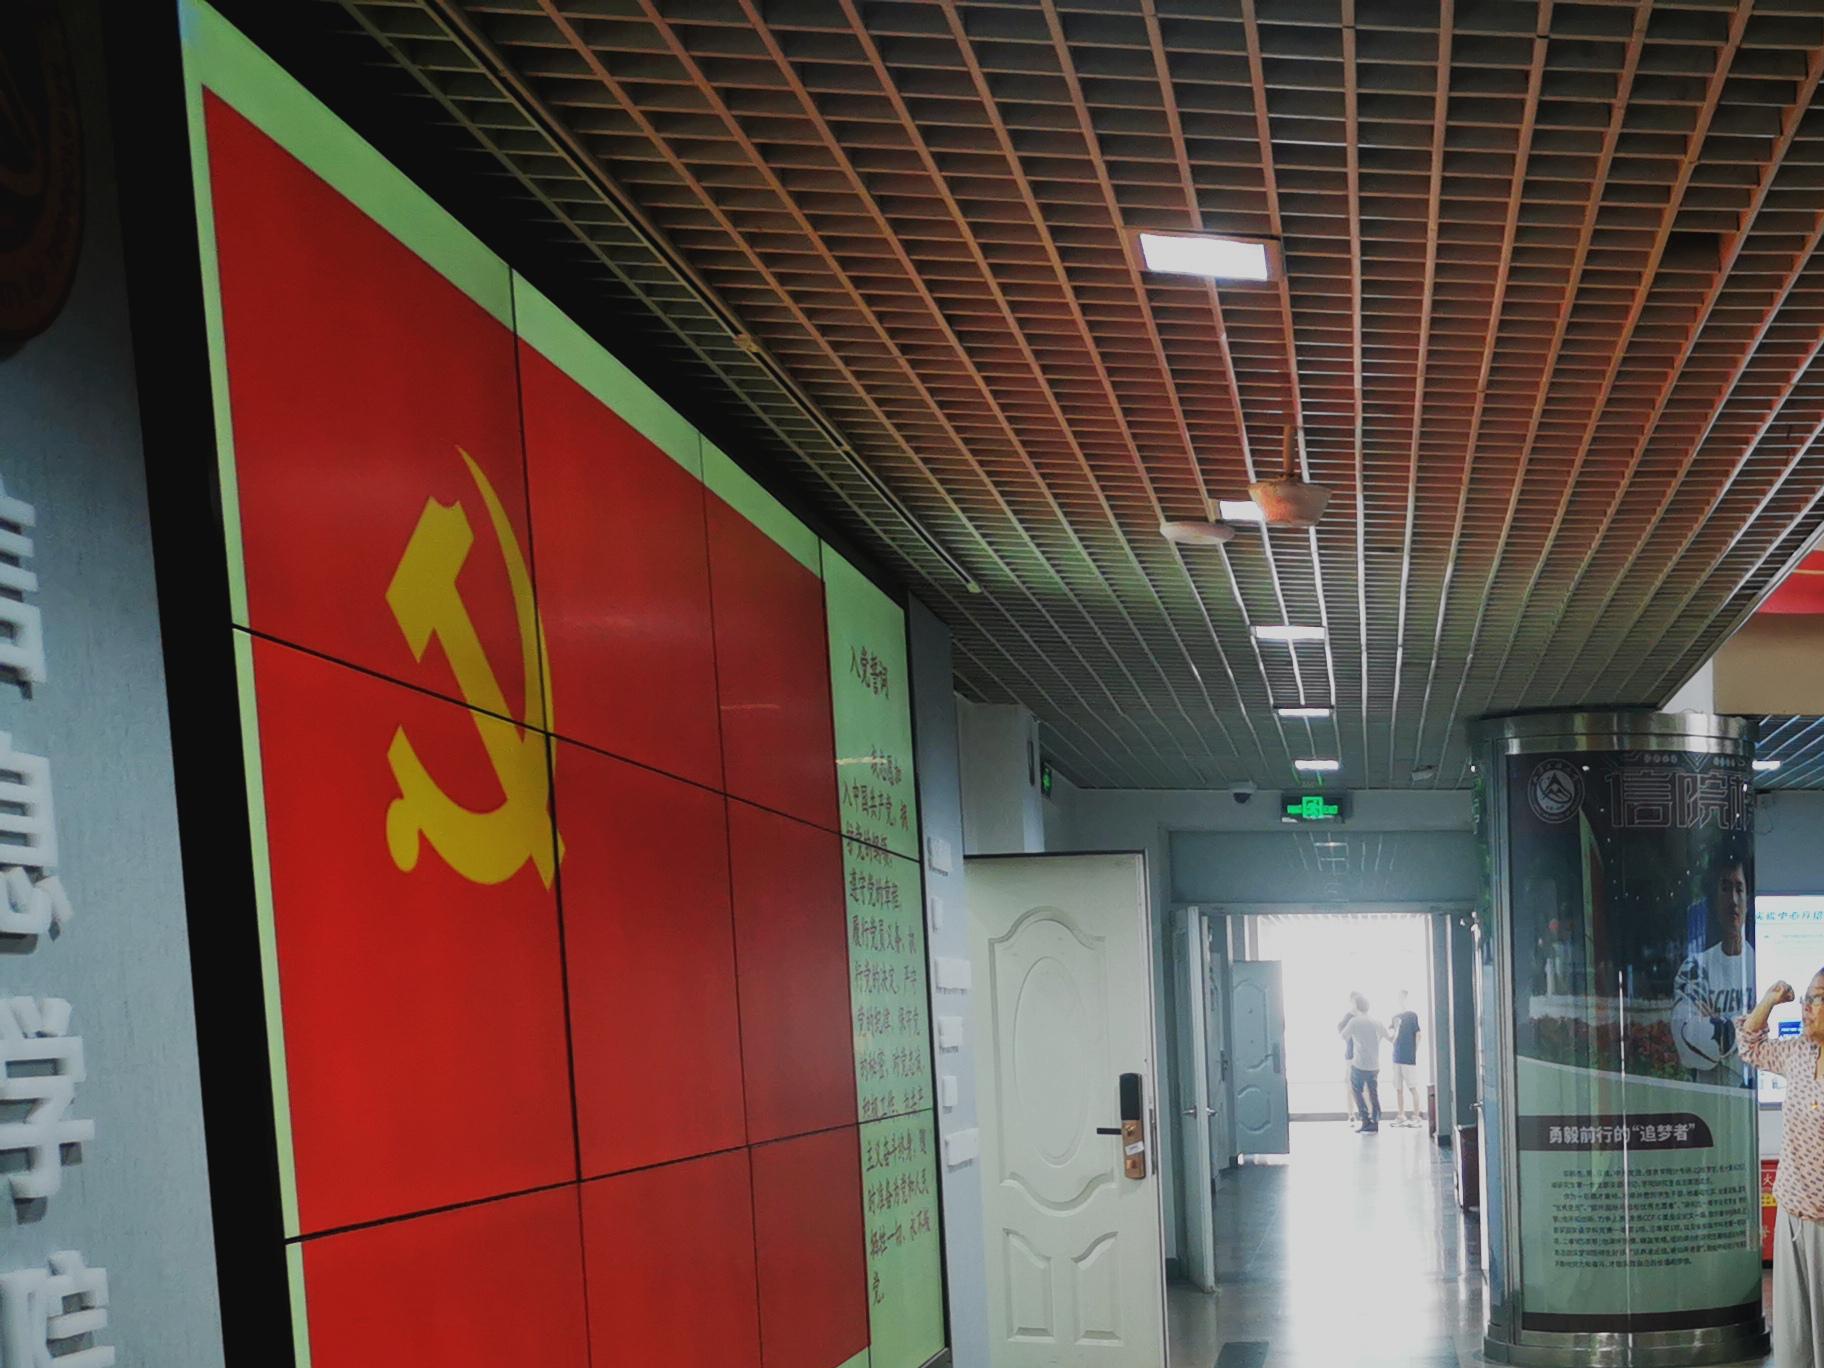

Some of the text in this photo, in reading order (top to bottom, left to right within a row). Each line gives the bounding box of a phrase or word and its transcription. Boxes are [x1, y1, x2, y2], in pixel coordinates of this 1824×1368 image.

[1549, 1122, 1696, 1144] 勇毅前行的“追梦者”
